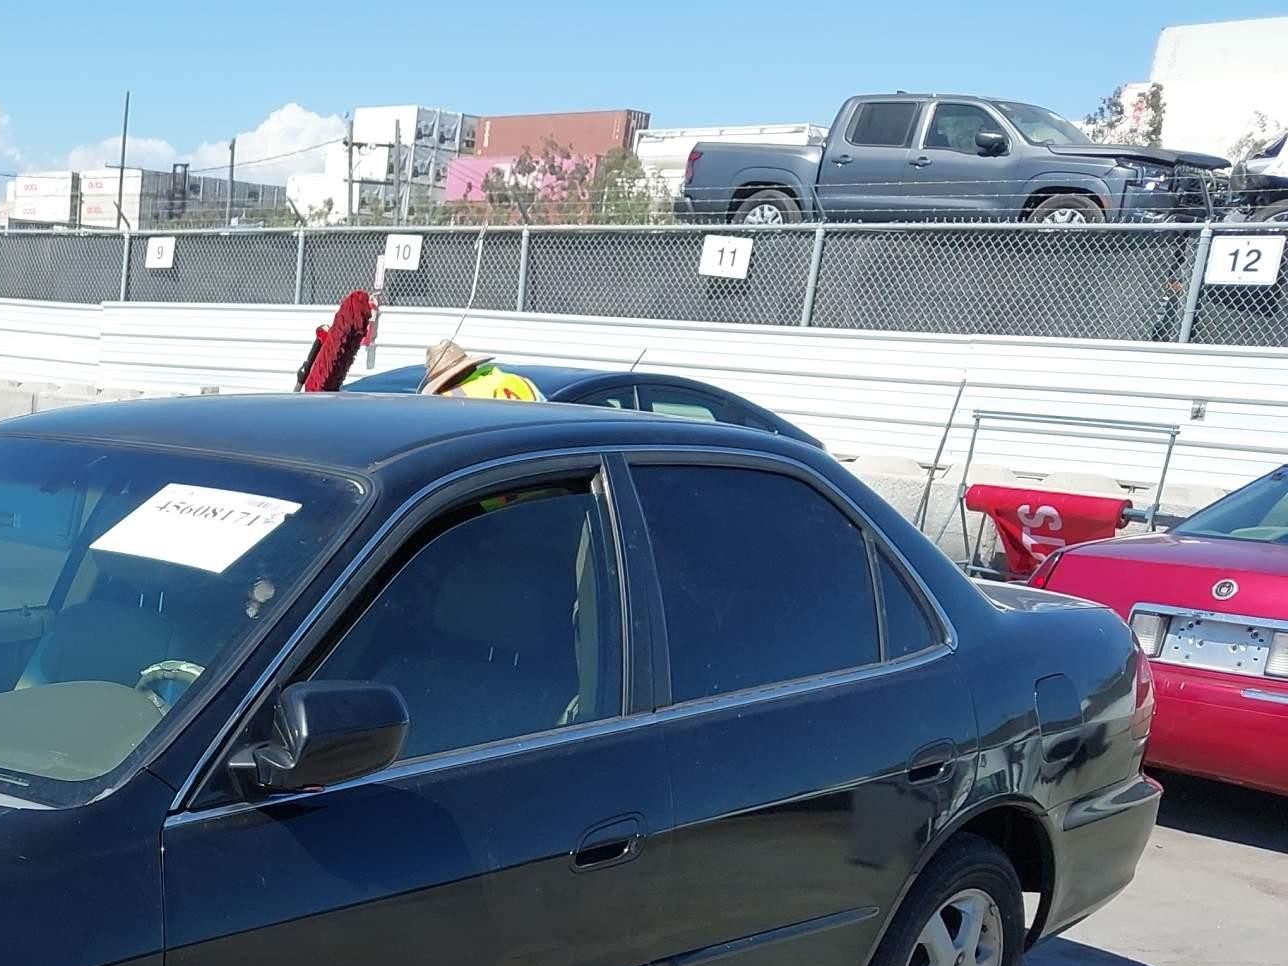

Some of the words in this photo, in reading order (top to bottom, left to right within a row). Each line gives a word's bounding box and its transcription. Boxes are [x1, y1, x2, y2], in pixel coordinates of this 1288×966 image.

[157, 246, 163, 259] 9
[395, 244, 411, 260] 10
[717, 247, 737, 267] 11
[1228, 248, 1263, 272] 12
